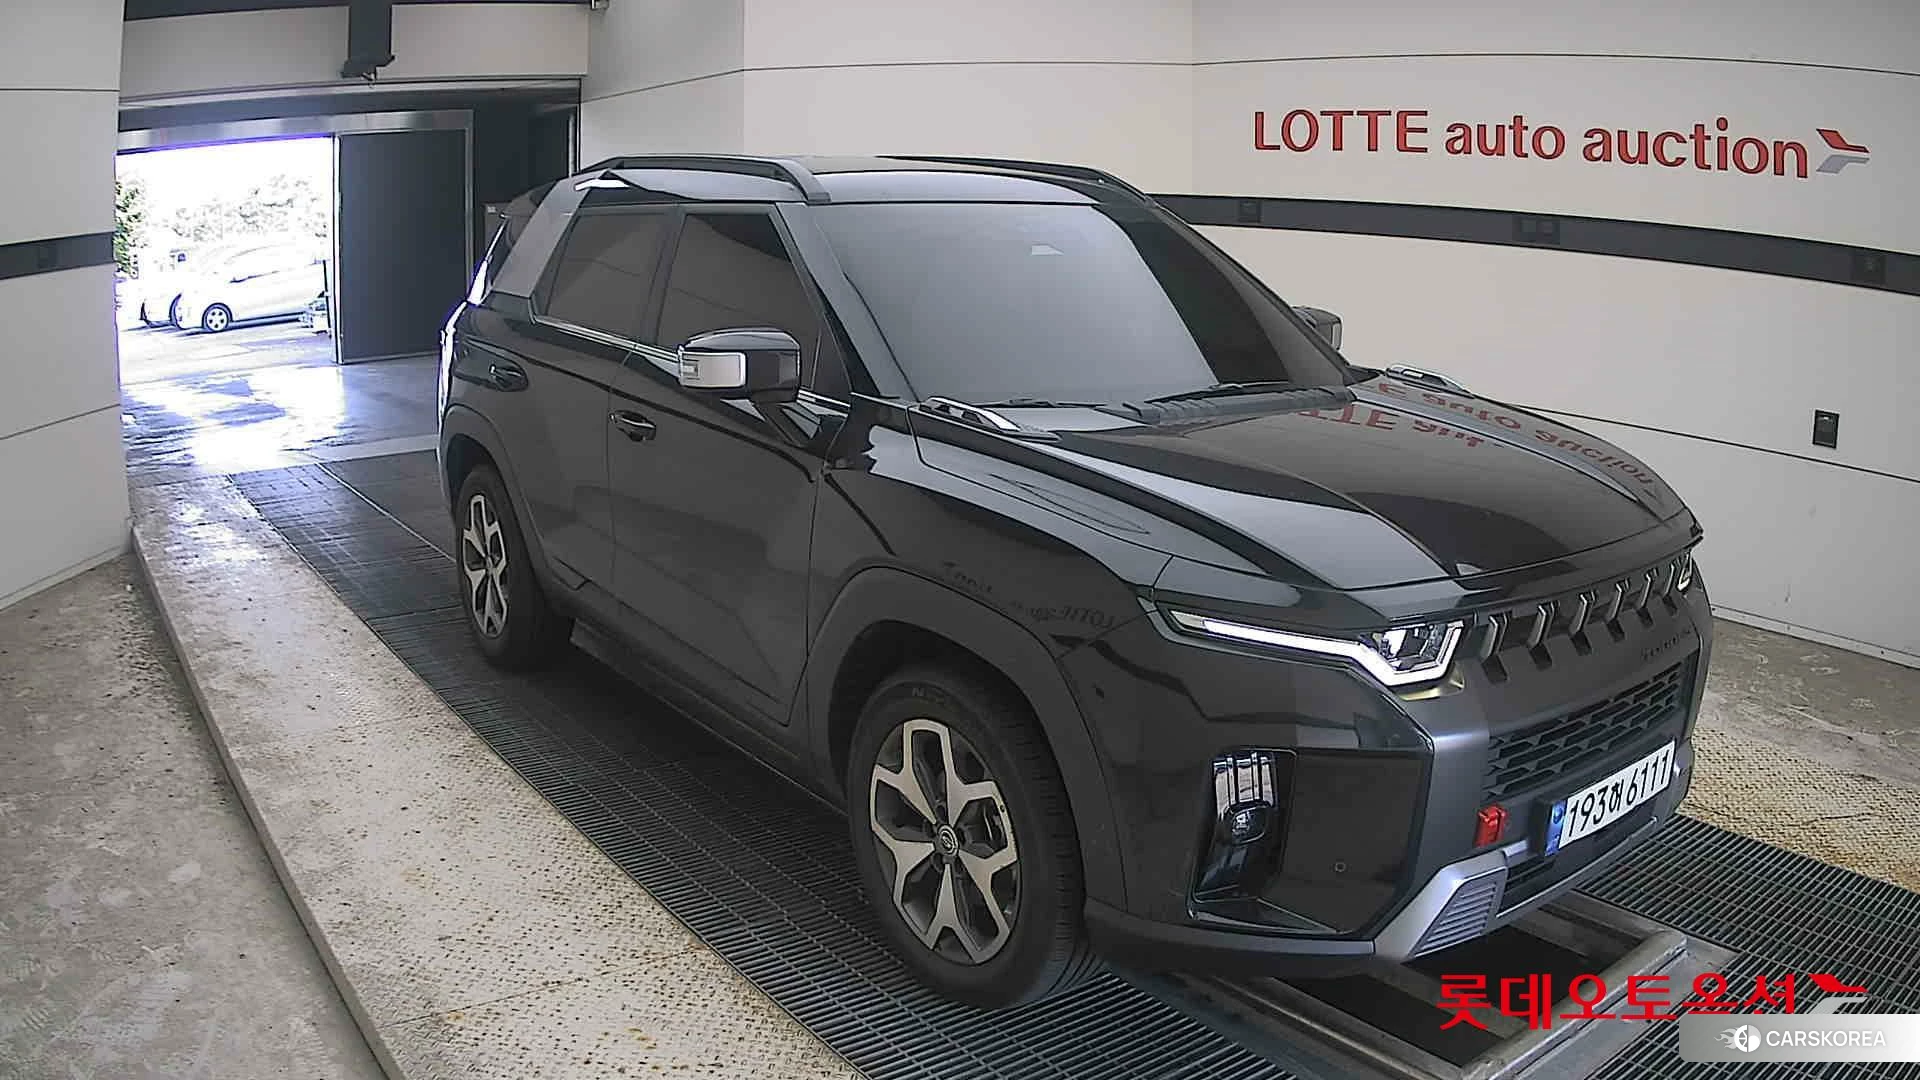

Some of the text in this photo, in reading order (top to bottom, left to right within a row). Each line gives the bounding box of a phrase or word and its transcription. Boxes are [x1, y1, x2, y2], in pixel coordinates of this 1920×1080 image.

[1254, 109, 1808, 179] LOTTE auto auction
